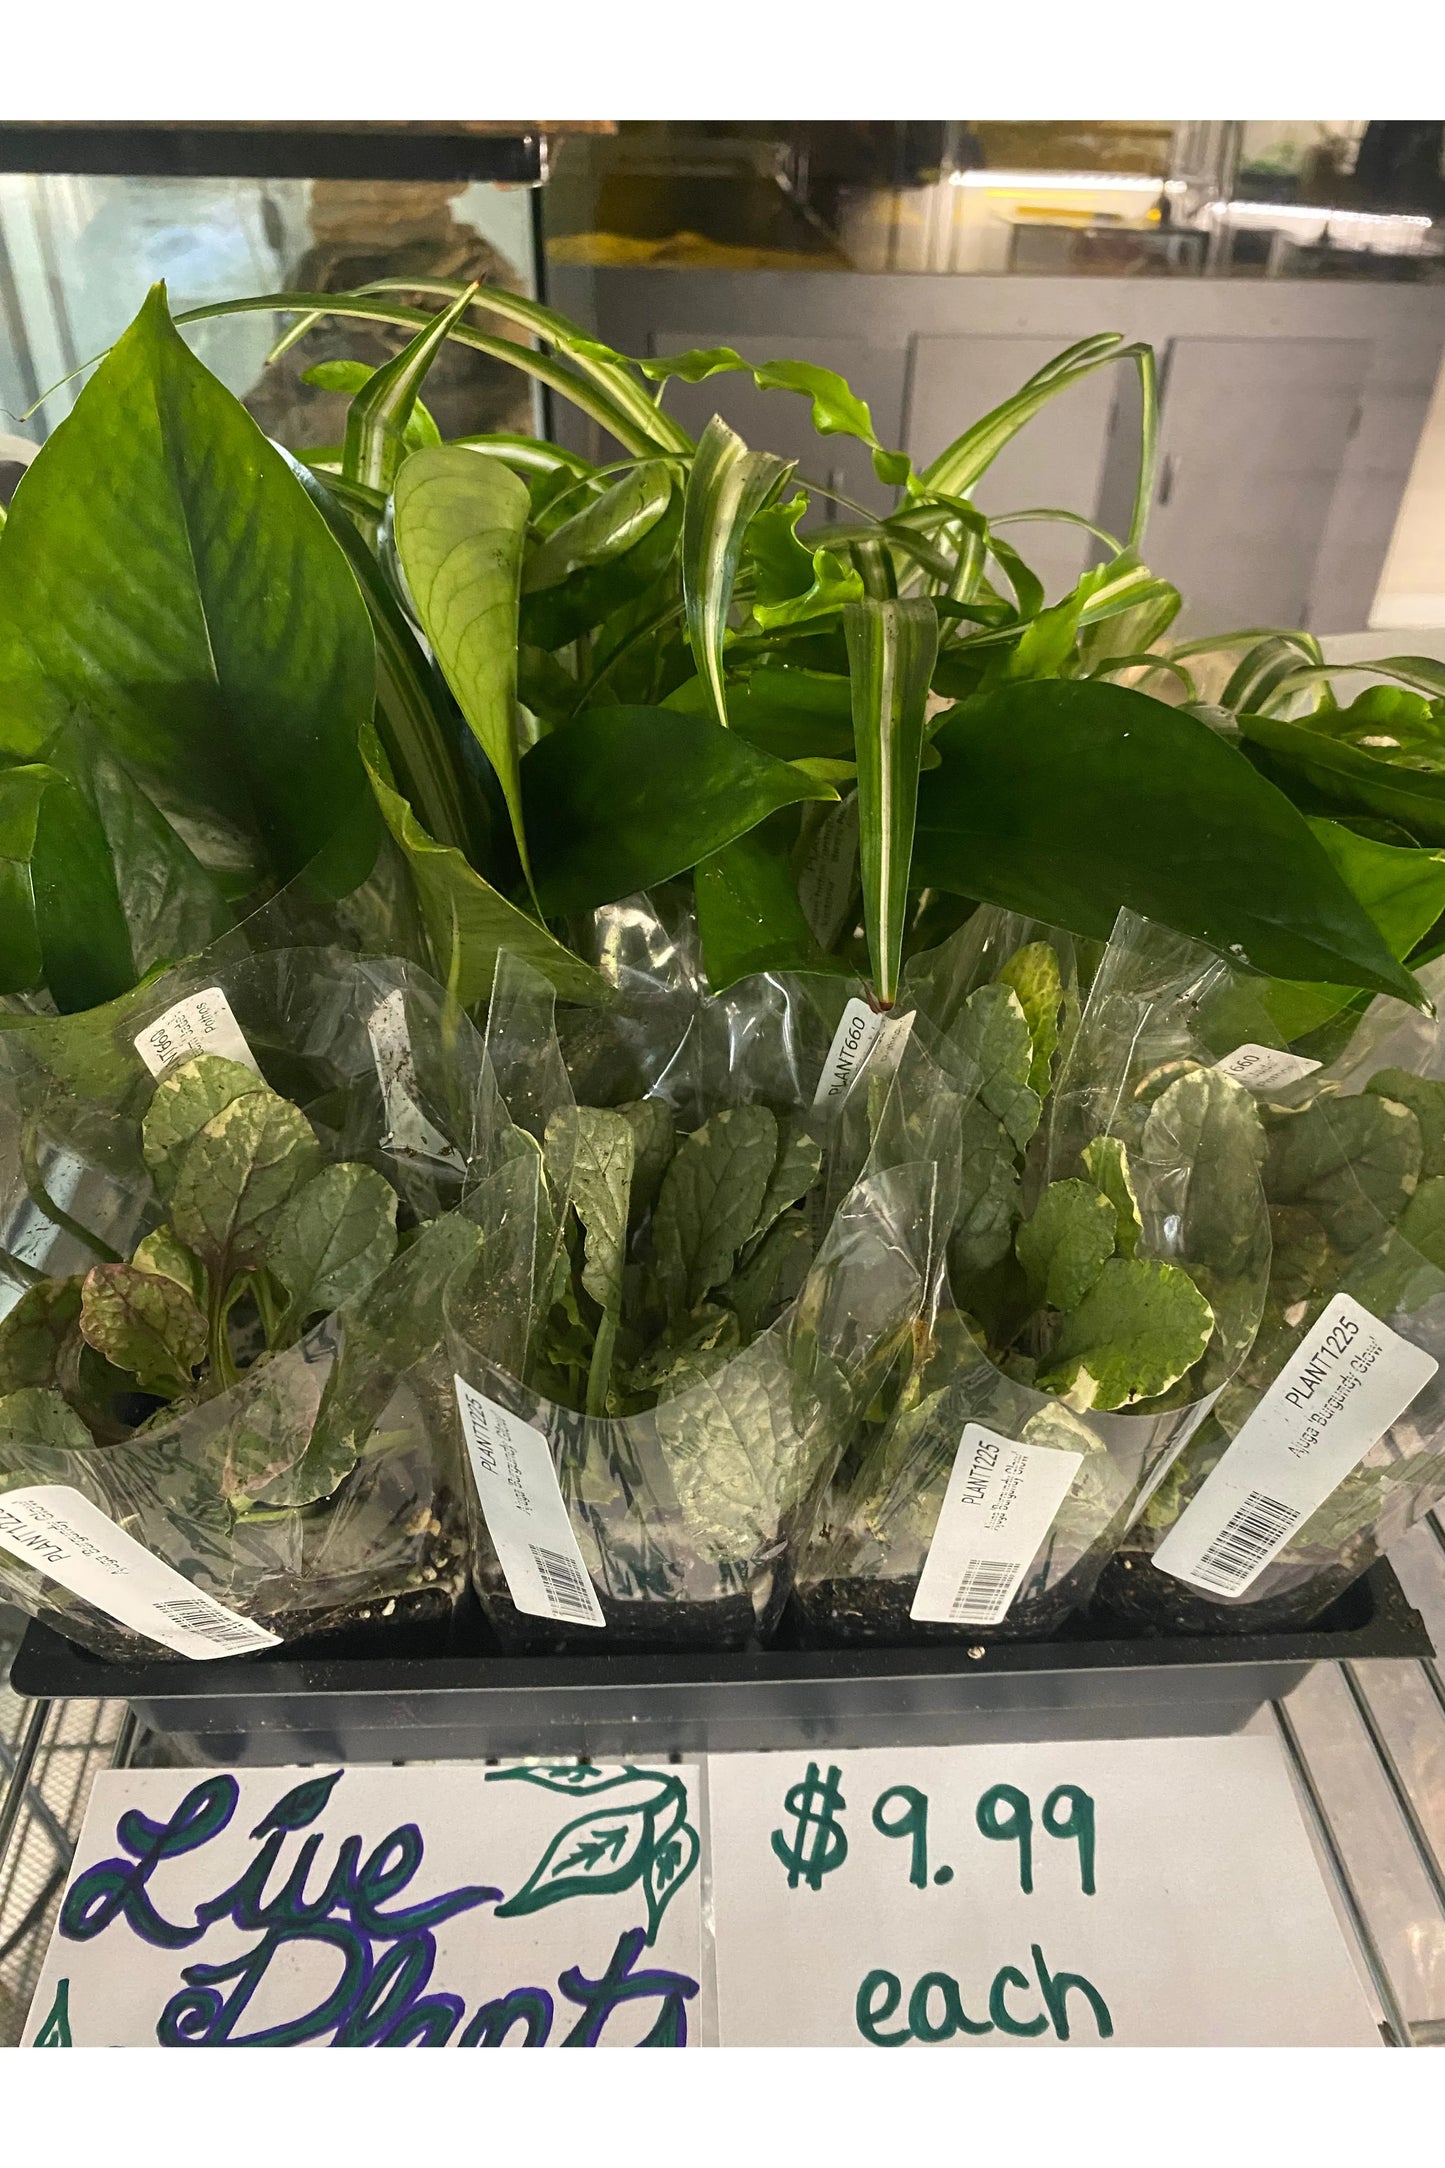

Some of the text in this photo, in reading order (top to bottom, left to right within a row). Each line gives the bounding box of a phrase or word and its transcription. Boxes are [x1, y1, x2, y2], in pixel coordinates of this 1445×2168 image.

[150, 1028, 184, 1073] ANT660
[828, 1016, 866, 1096] PLANT660
[1284, 1315, 1360, 1409] PLANT1225
[465, 1393, 499, 1475] PLANT1225
[961, 1440, 1000, 1506] PLANT1225
[1287, 1426, 1321, 1459] Ajuga
[0, 1508, 71, 1563] PLANT122
[60, 1768, 504, 1950] Live
[770, 1761, 1097, 1896] $9.99
[856, 1943, 1114, 2047] each
